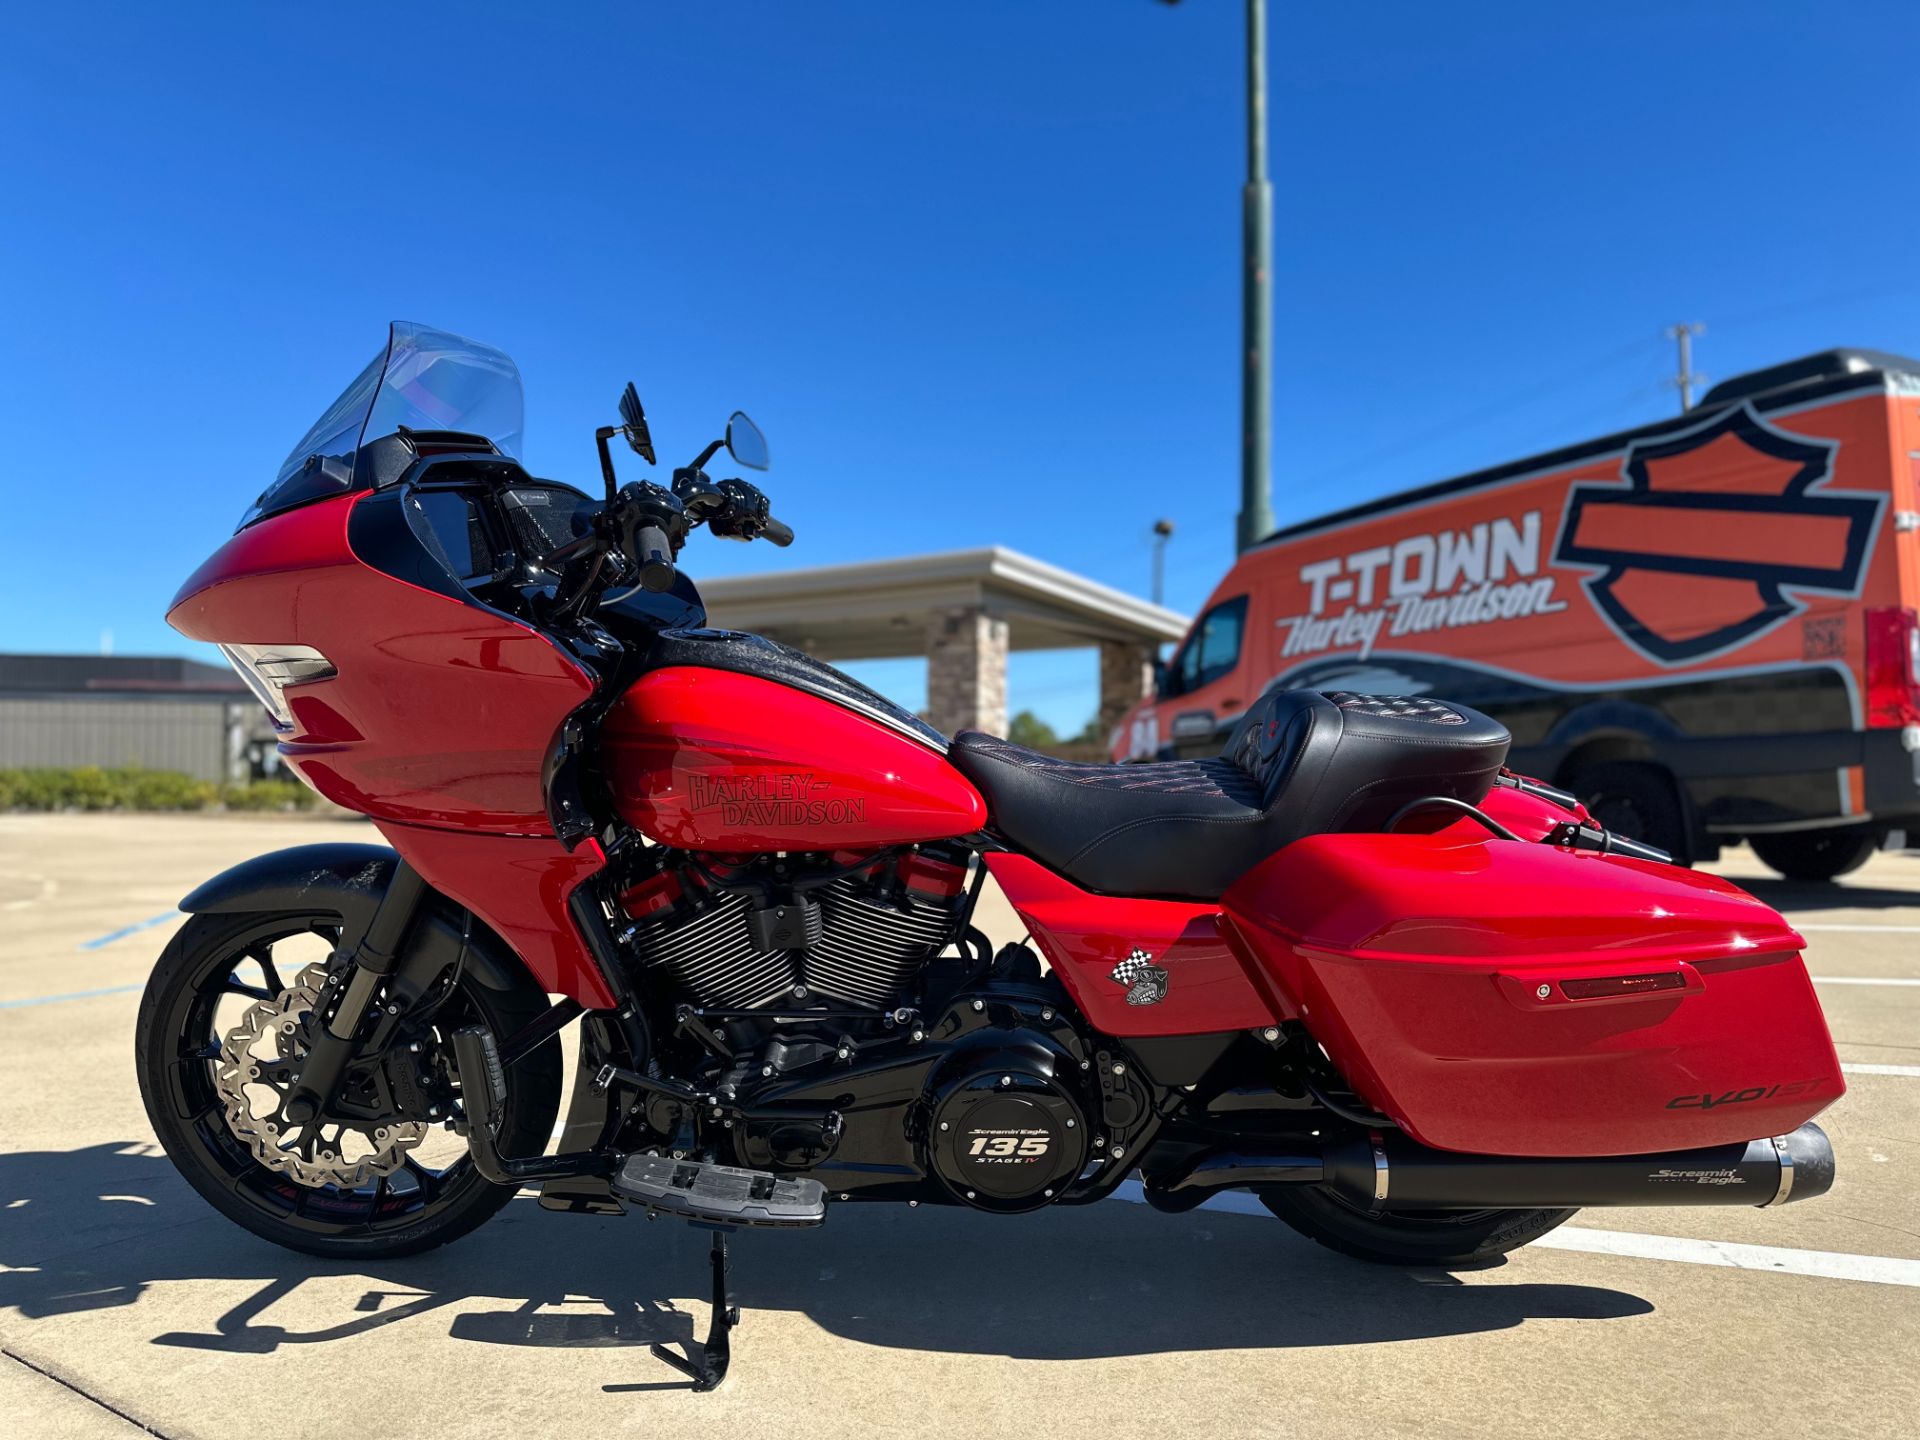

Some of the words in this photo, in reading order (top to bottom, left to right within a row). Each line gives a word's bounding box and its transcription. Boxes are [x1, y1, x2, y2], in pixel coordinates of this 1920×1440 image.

[1300, 510, 1541, 615] T-TOWN
[722, 798, 867, 826] DAVIDSON
[968, 1137, 1051, 1156] 135
